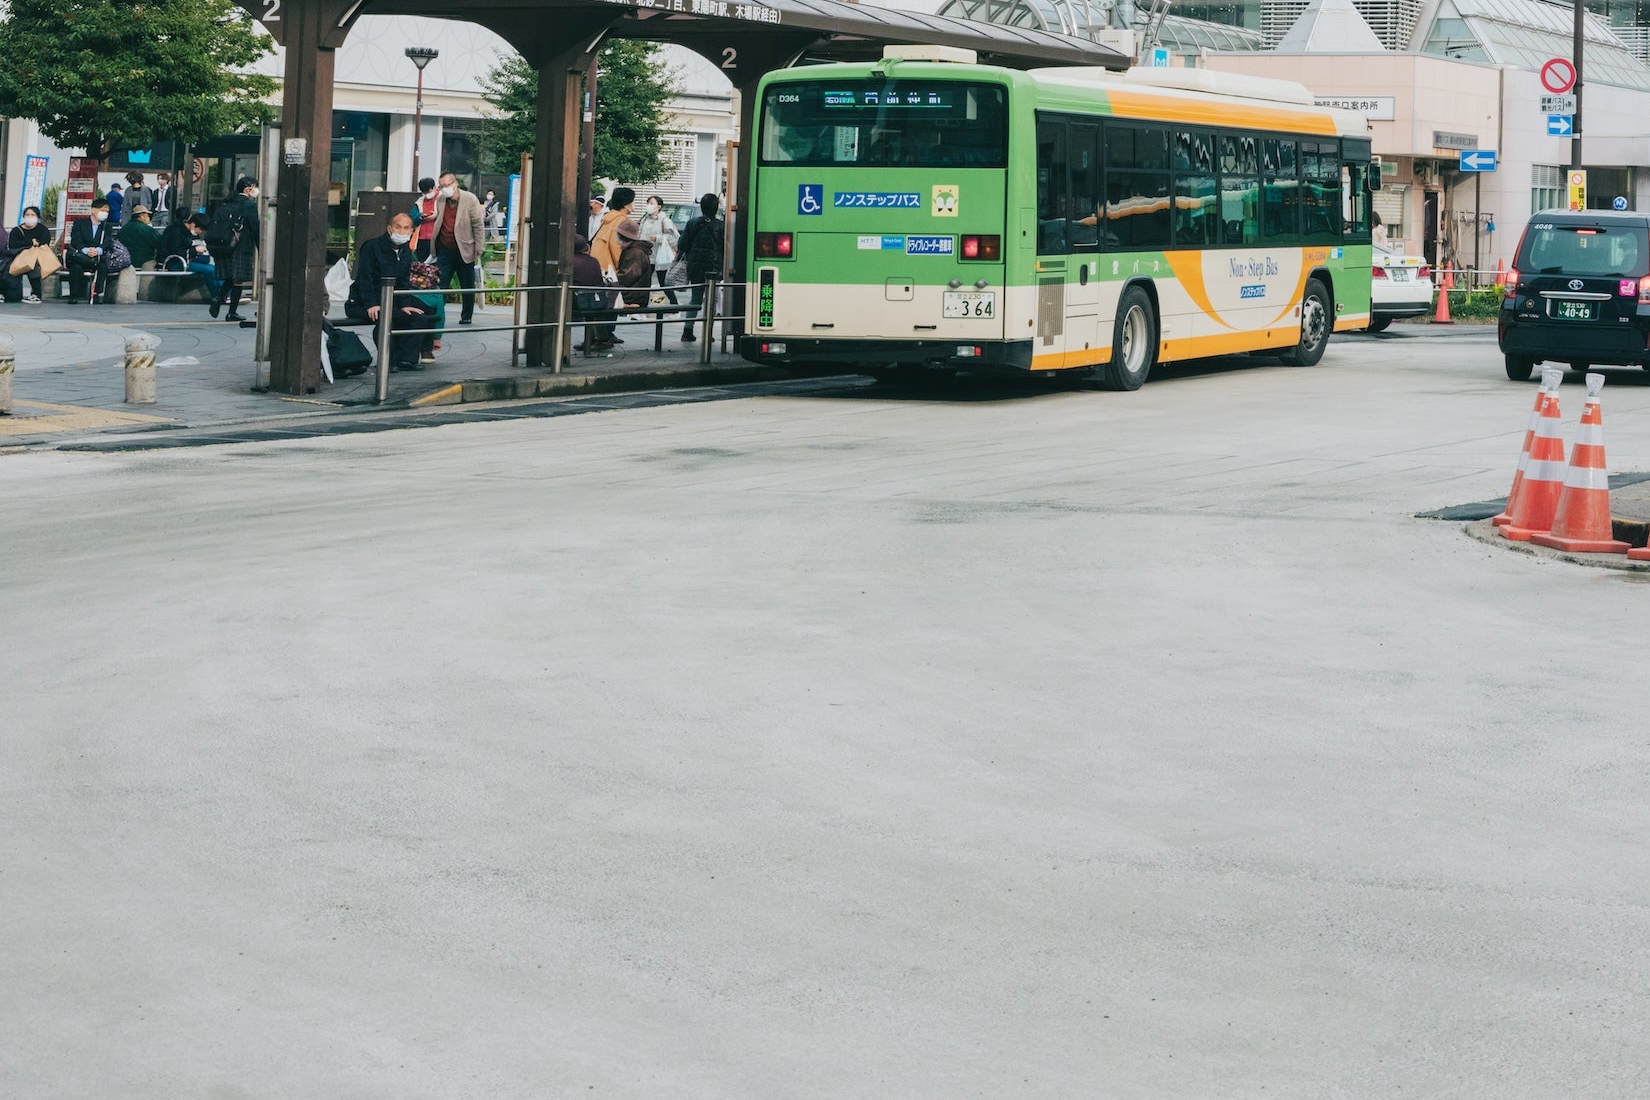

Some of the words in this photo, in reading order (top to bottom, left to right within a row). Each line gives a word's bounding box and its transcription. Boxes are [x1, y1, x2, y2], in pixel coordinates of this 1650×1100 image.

[721, 46, 738, 69] 2
[778, 94, 800, 103] D364
[835, 193, 920, 207] ノンステップバス
[1265, 256, 1279, 276] Bus
[760, 283, 774, 328] 乗降中
[1565, 308, 1590, 319] 40-49
